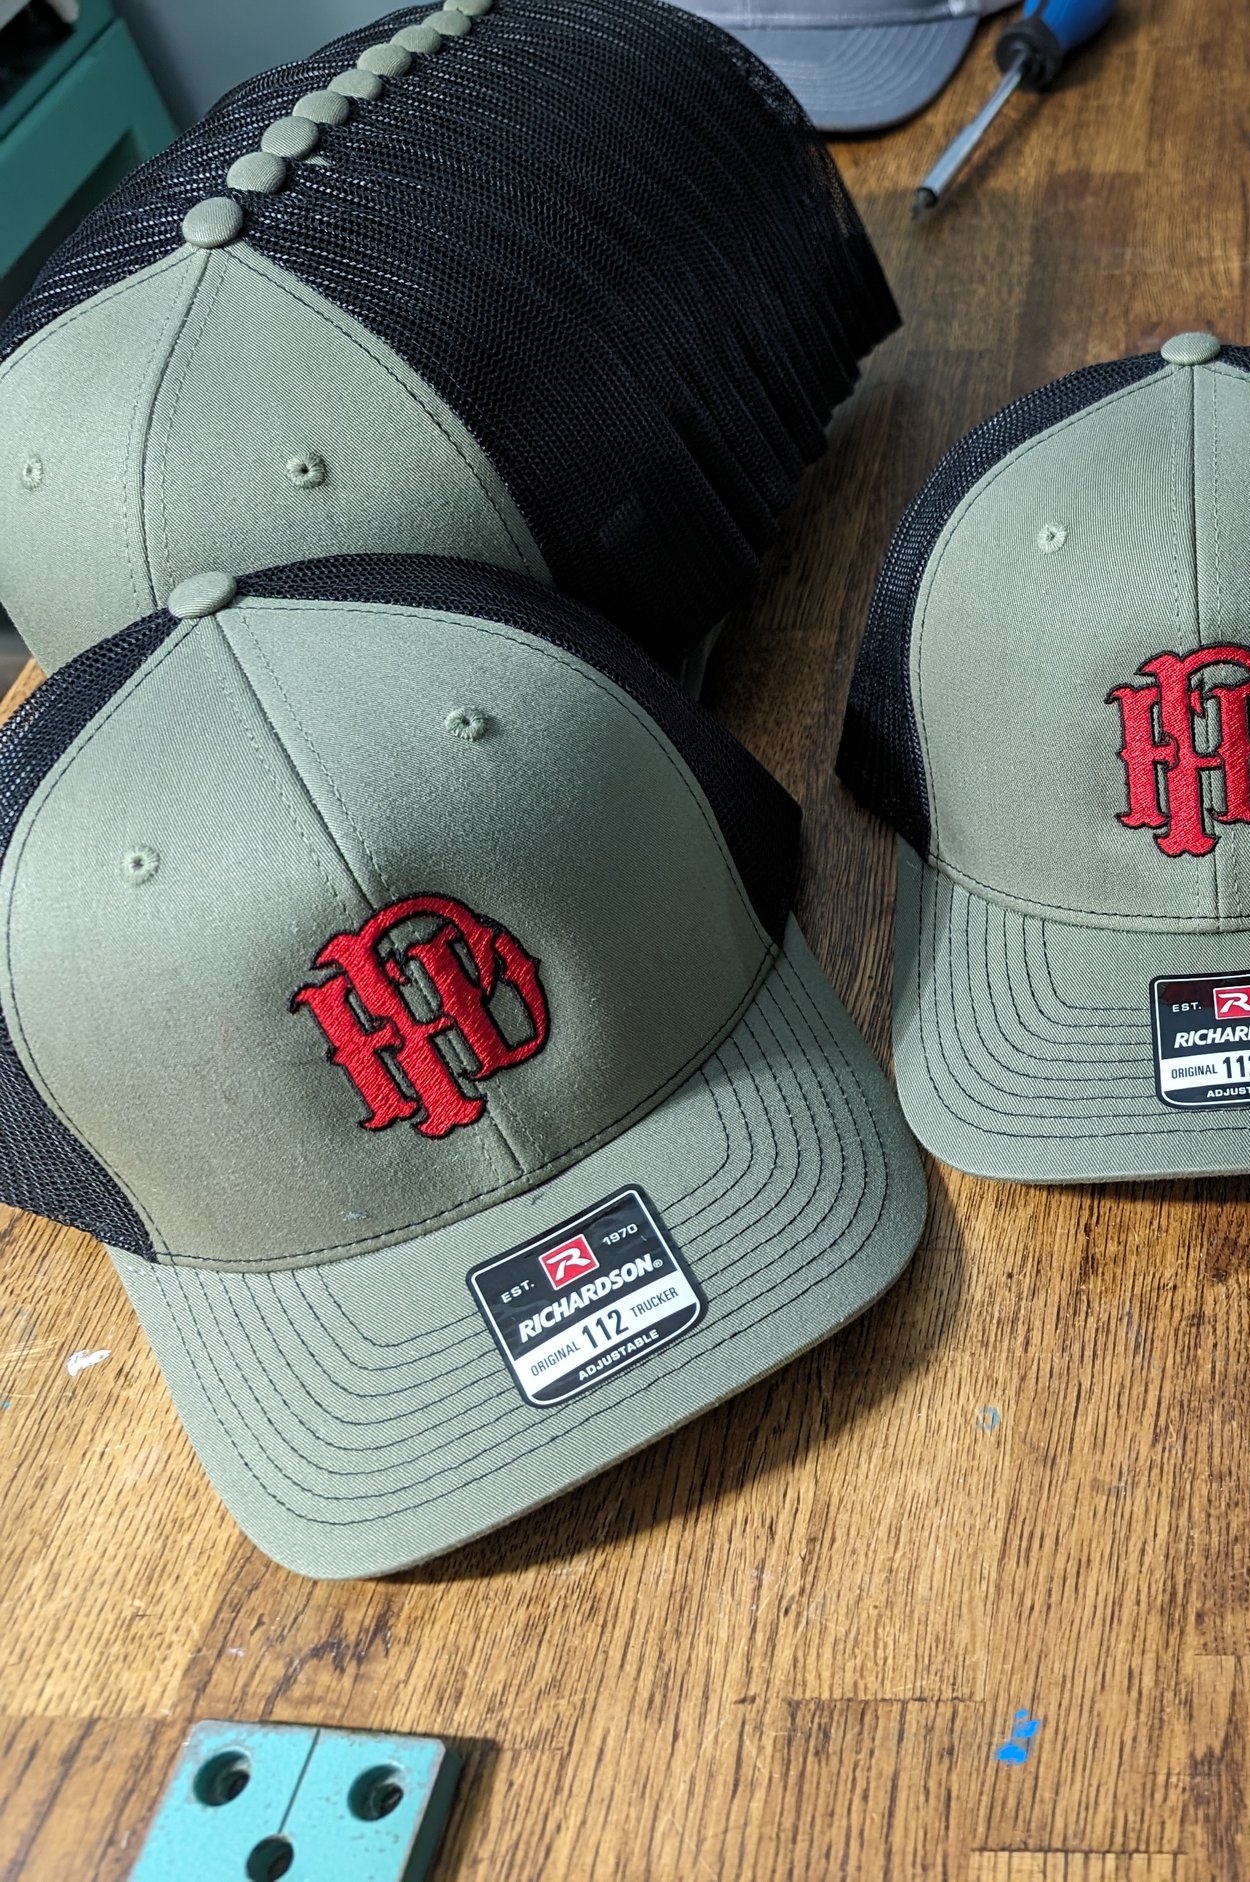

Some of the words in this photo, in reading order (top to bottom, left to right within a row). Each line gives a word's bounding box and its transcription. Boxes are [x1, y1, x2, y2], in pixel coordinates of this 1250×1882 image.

[1172, 1002, 1201, 1012] EST.
[1171, 1064, 1218, 1079] ORIGINAL
[501, 1280, 535, 1303] EST.
[602, 1223, 638, 1246] 1970
[530, 1341, 580, 1377] ORIGINAL
[582, 1308, 629, 1349] 112
[629, 1286, 679, 1318] TRUCKER
[578, 1329, 659, 1381] ADJUSTABLE
